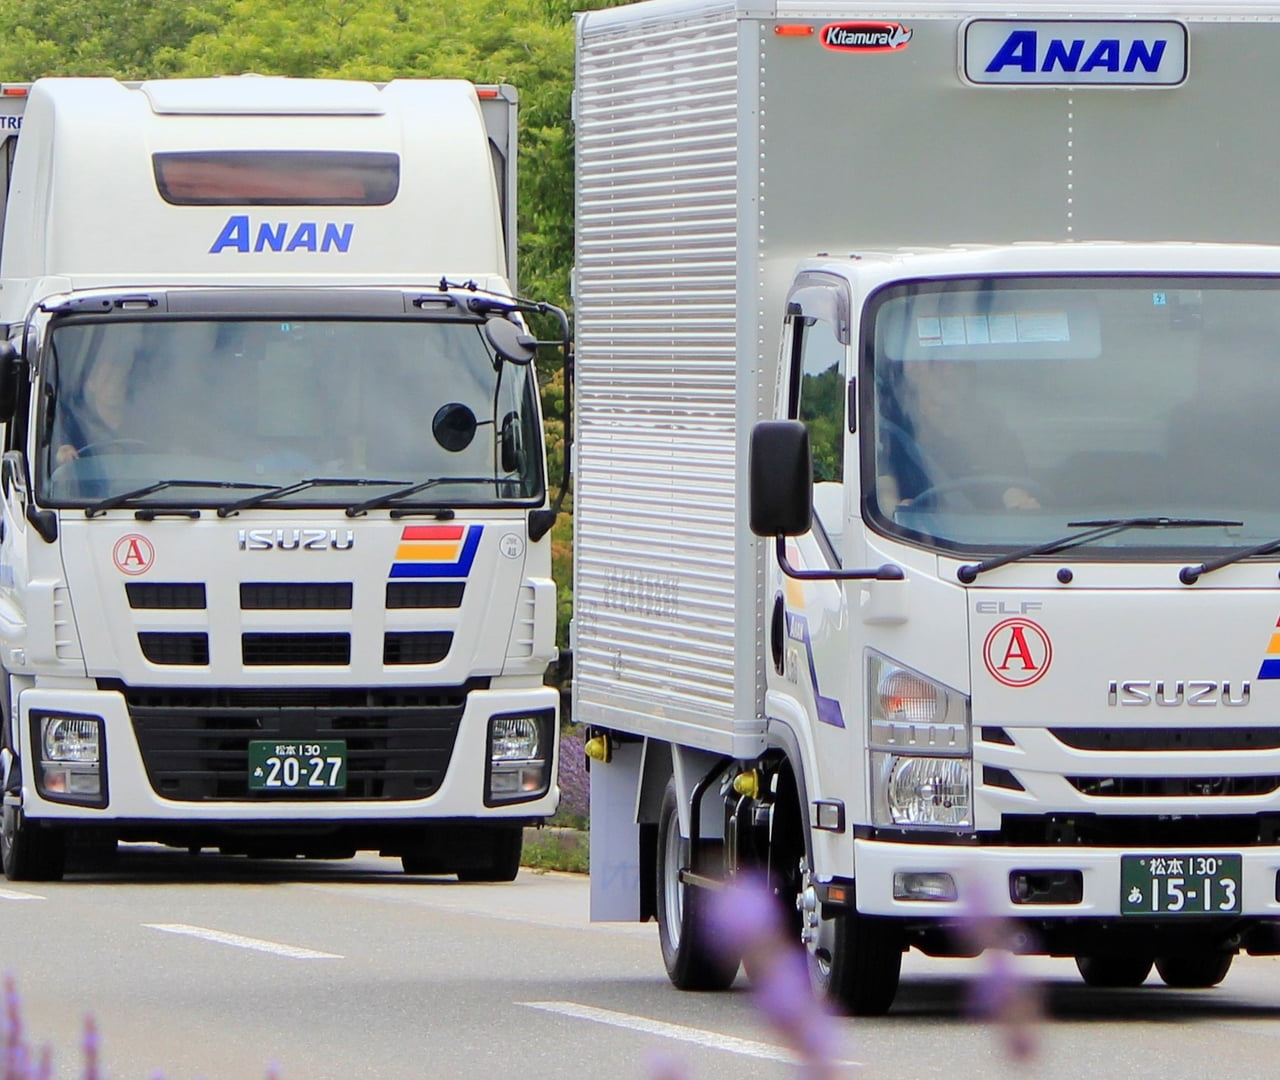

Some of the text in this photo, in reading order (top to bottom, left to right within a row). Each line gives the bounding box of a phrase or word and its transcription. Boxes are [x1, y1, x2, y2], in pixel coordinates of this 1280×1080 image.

[826, 27, 888, 45] Kitamura
[123, 539, 146, 565] A
[239, 529, 354, 551] ISUZU
[975, 601, 1043, 615] ELF
[996, 626, 1039, 670] A
[1107, 679, 1251, 707] ISUZU
[299, 745, 321, 756] 130
[266, 757, 342, 787] 20-27
[1150, 858, 1216, 875] 松本 130
[1128, 878, 1236, 911] あ 15-13
